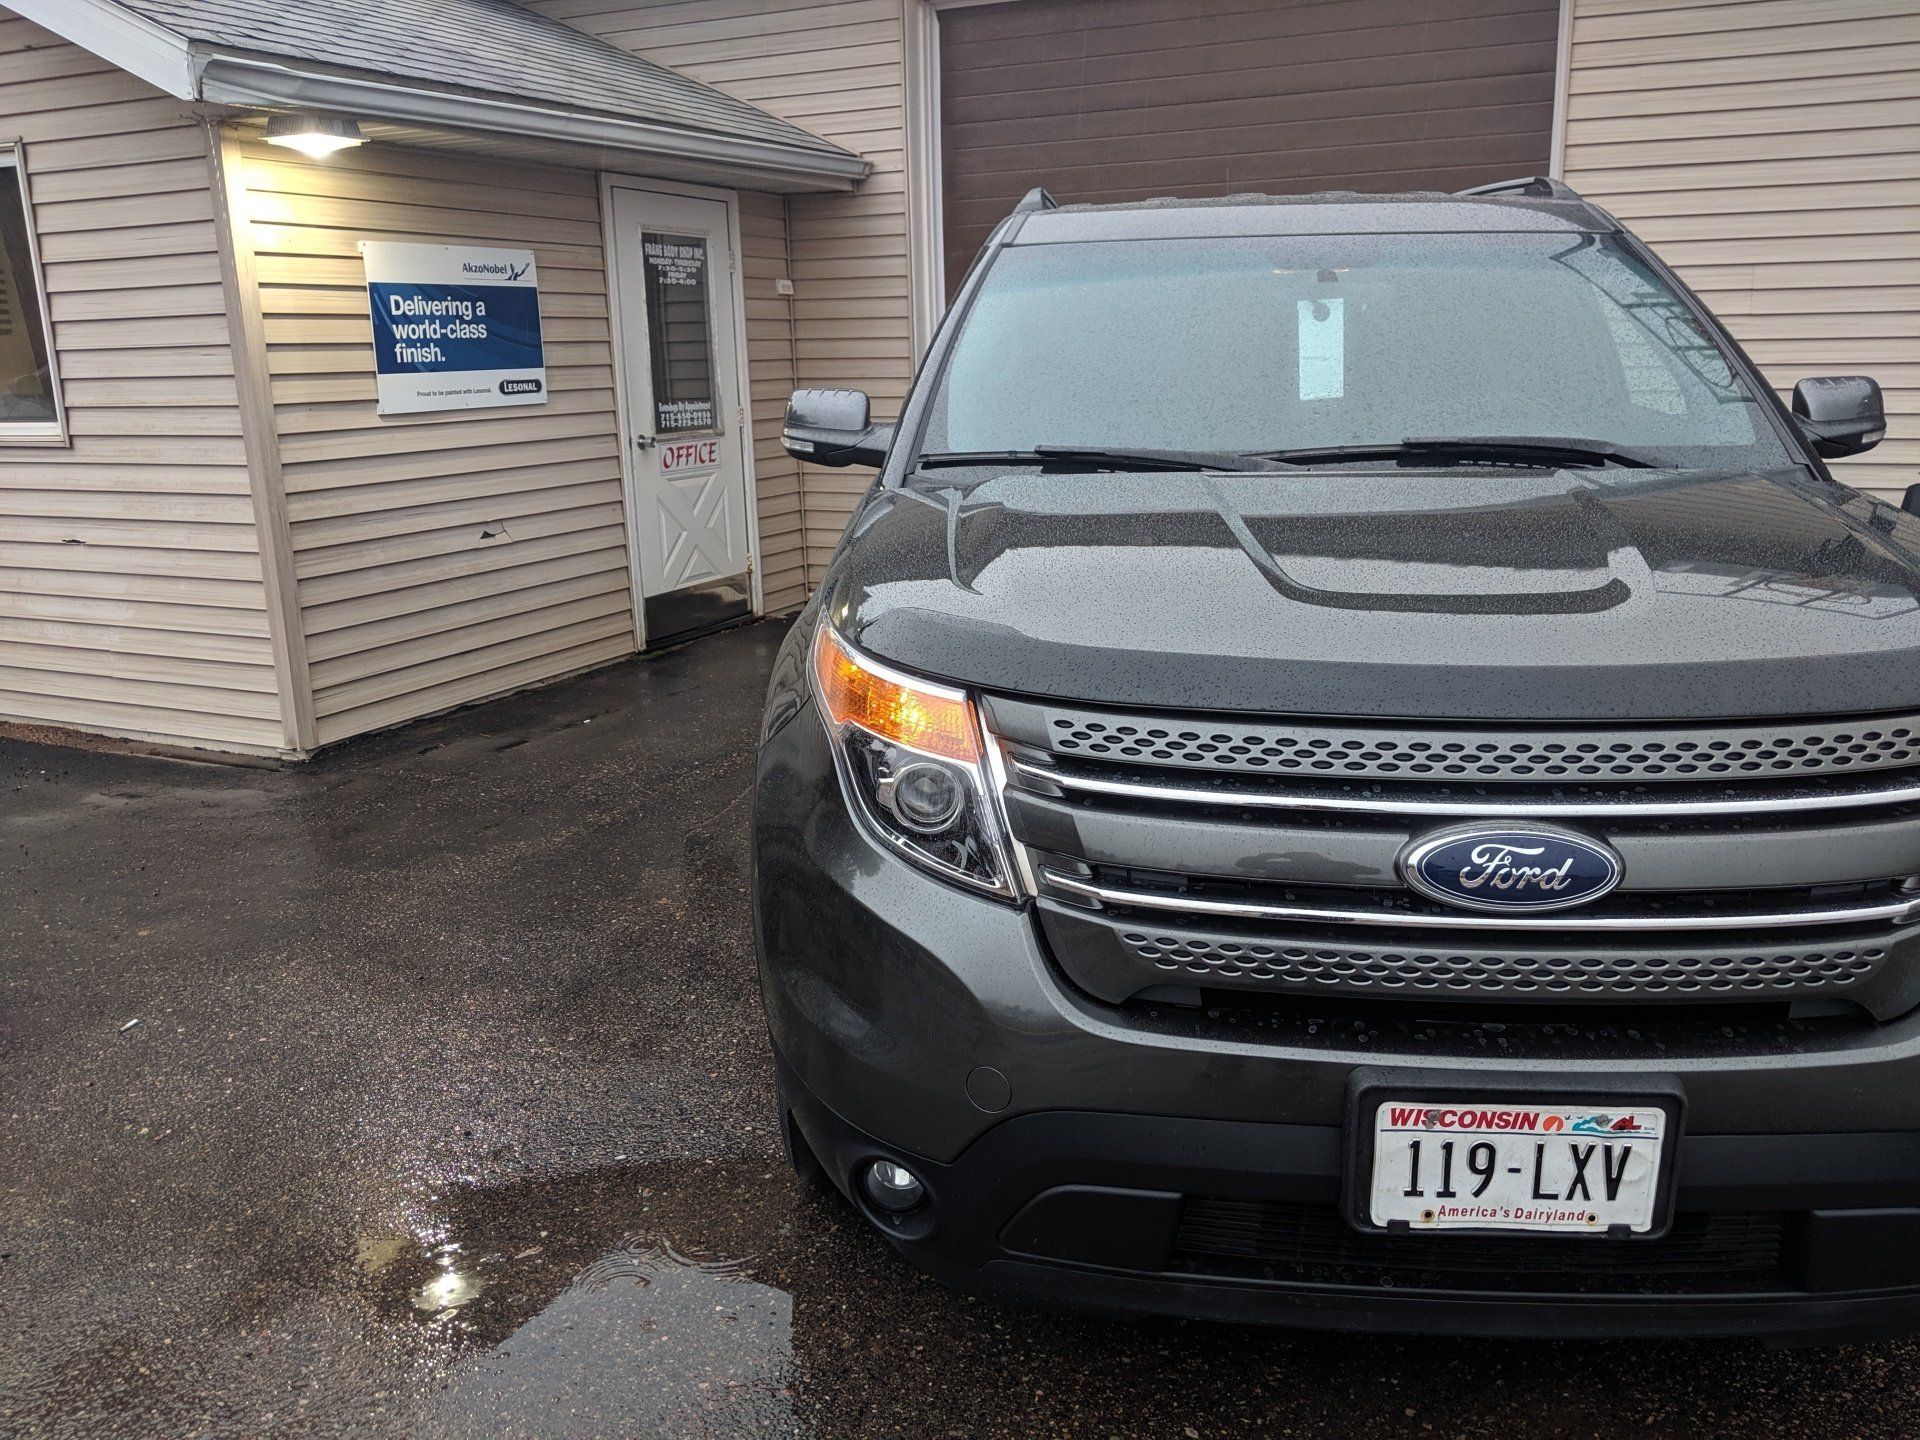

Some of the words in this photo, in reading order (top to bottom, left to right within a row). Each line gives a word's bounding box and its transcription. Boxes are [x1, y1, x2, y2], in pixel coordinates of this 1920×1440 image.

[680, 246, 693, 258] SHOP
[462, 262, 507, 274] AkzoNobel
[390, 294, 472, 320] Delivering
[476, 300, 486, 316] a
[392, 320, 487, 340] world-class
[394, 342, 446, 363] finish.
[663, 442, 718, 468] OFFICE
[1460, 844, 1574, 891] Ford
[1390, 1108, 1540, 1130] WISCONSIN
[1403, 1138, 1632, 1202] 119-LXV
[1438, 1204, 1511, 1219] America's
[1514, 1206, 1586, 1223] Dairyland
